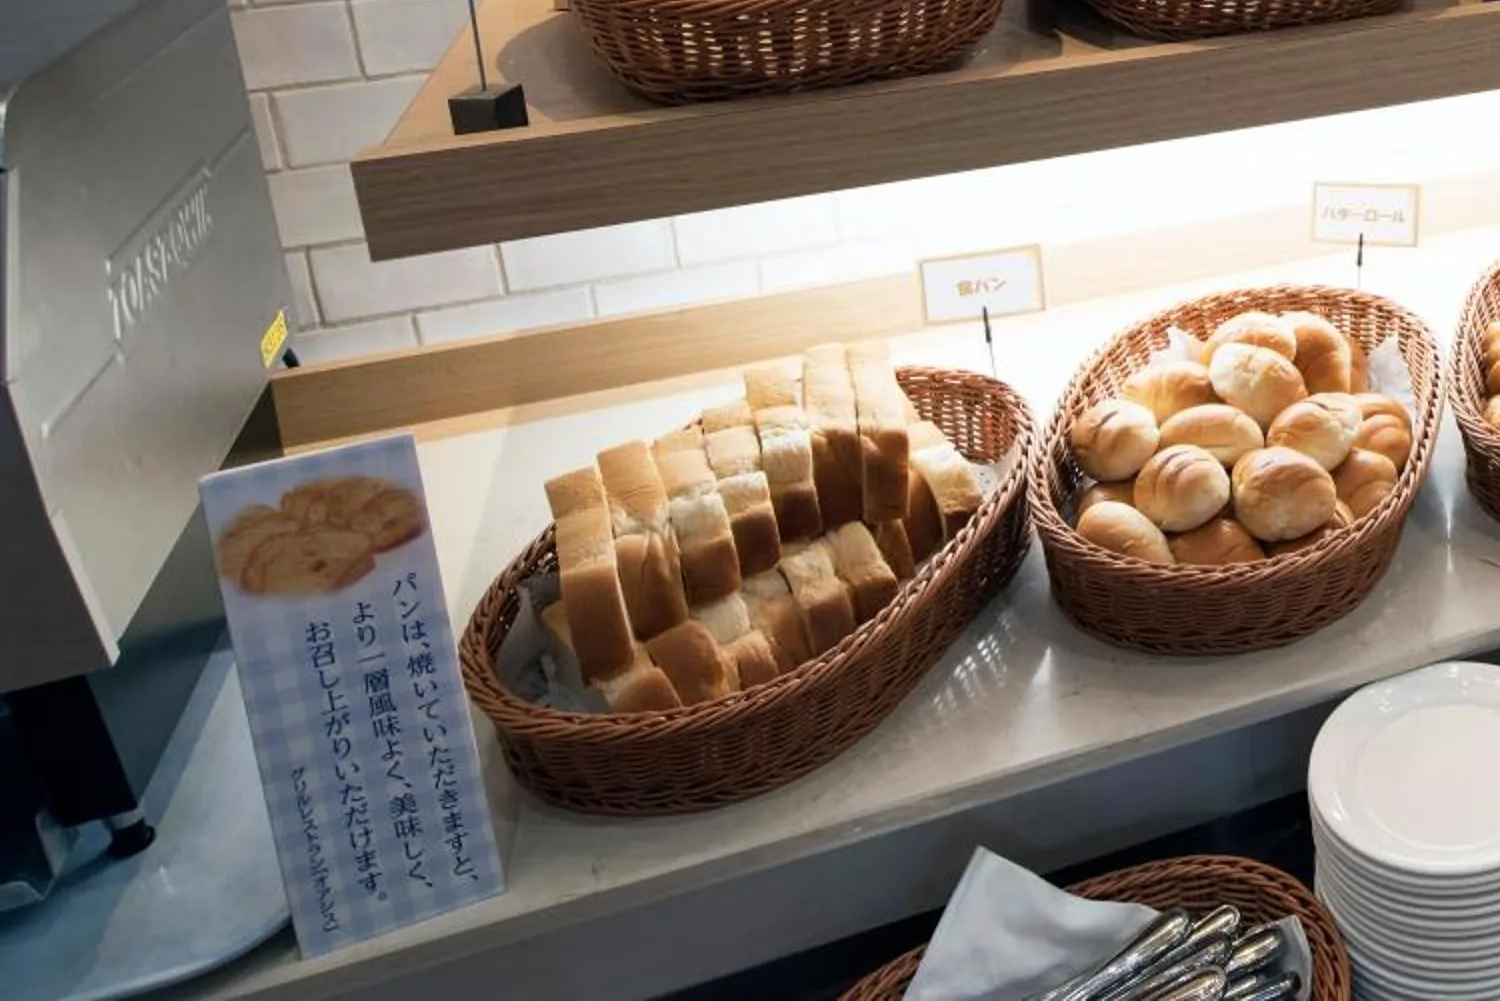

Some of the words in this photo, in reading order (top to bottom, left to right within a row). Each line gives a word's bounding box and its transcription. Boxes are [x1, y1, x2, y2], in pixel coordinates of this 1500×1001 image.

[305, 621, 388, 900] お召し上がりいただけます。
[352, 602, 433, 889] より一層風味よく、美味しく、
[392, 571, 479, 882] パンは、焼いていただきますと、
